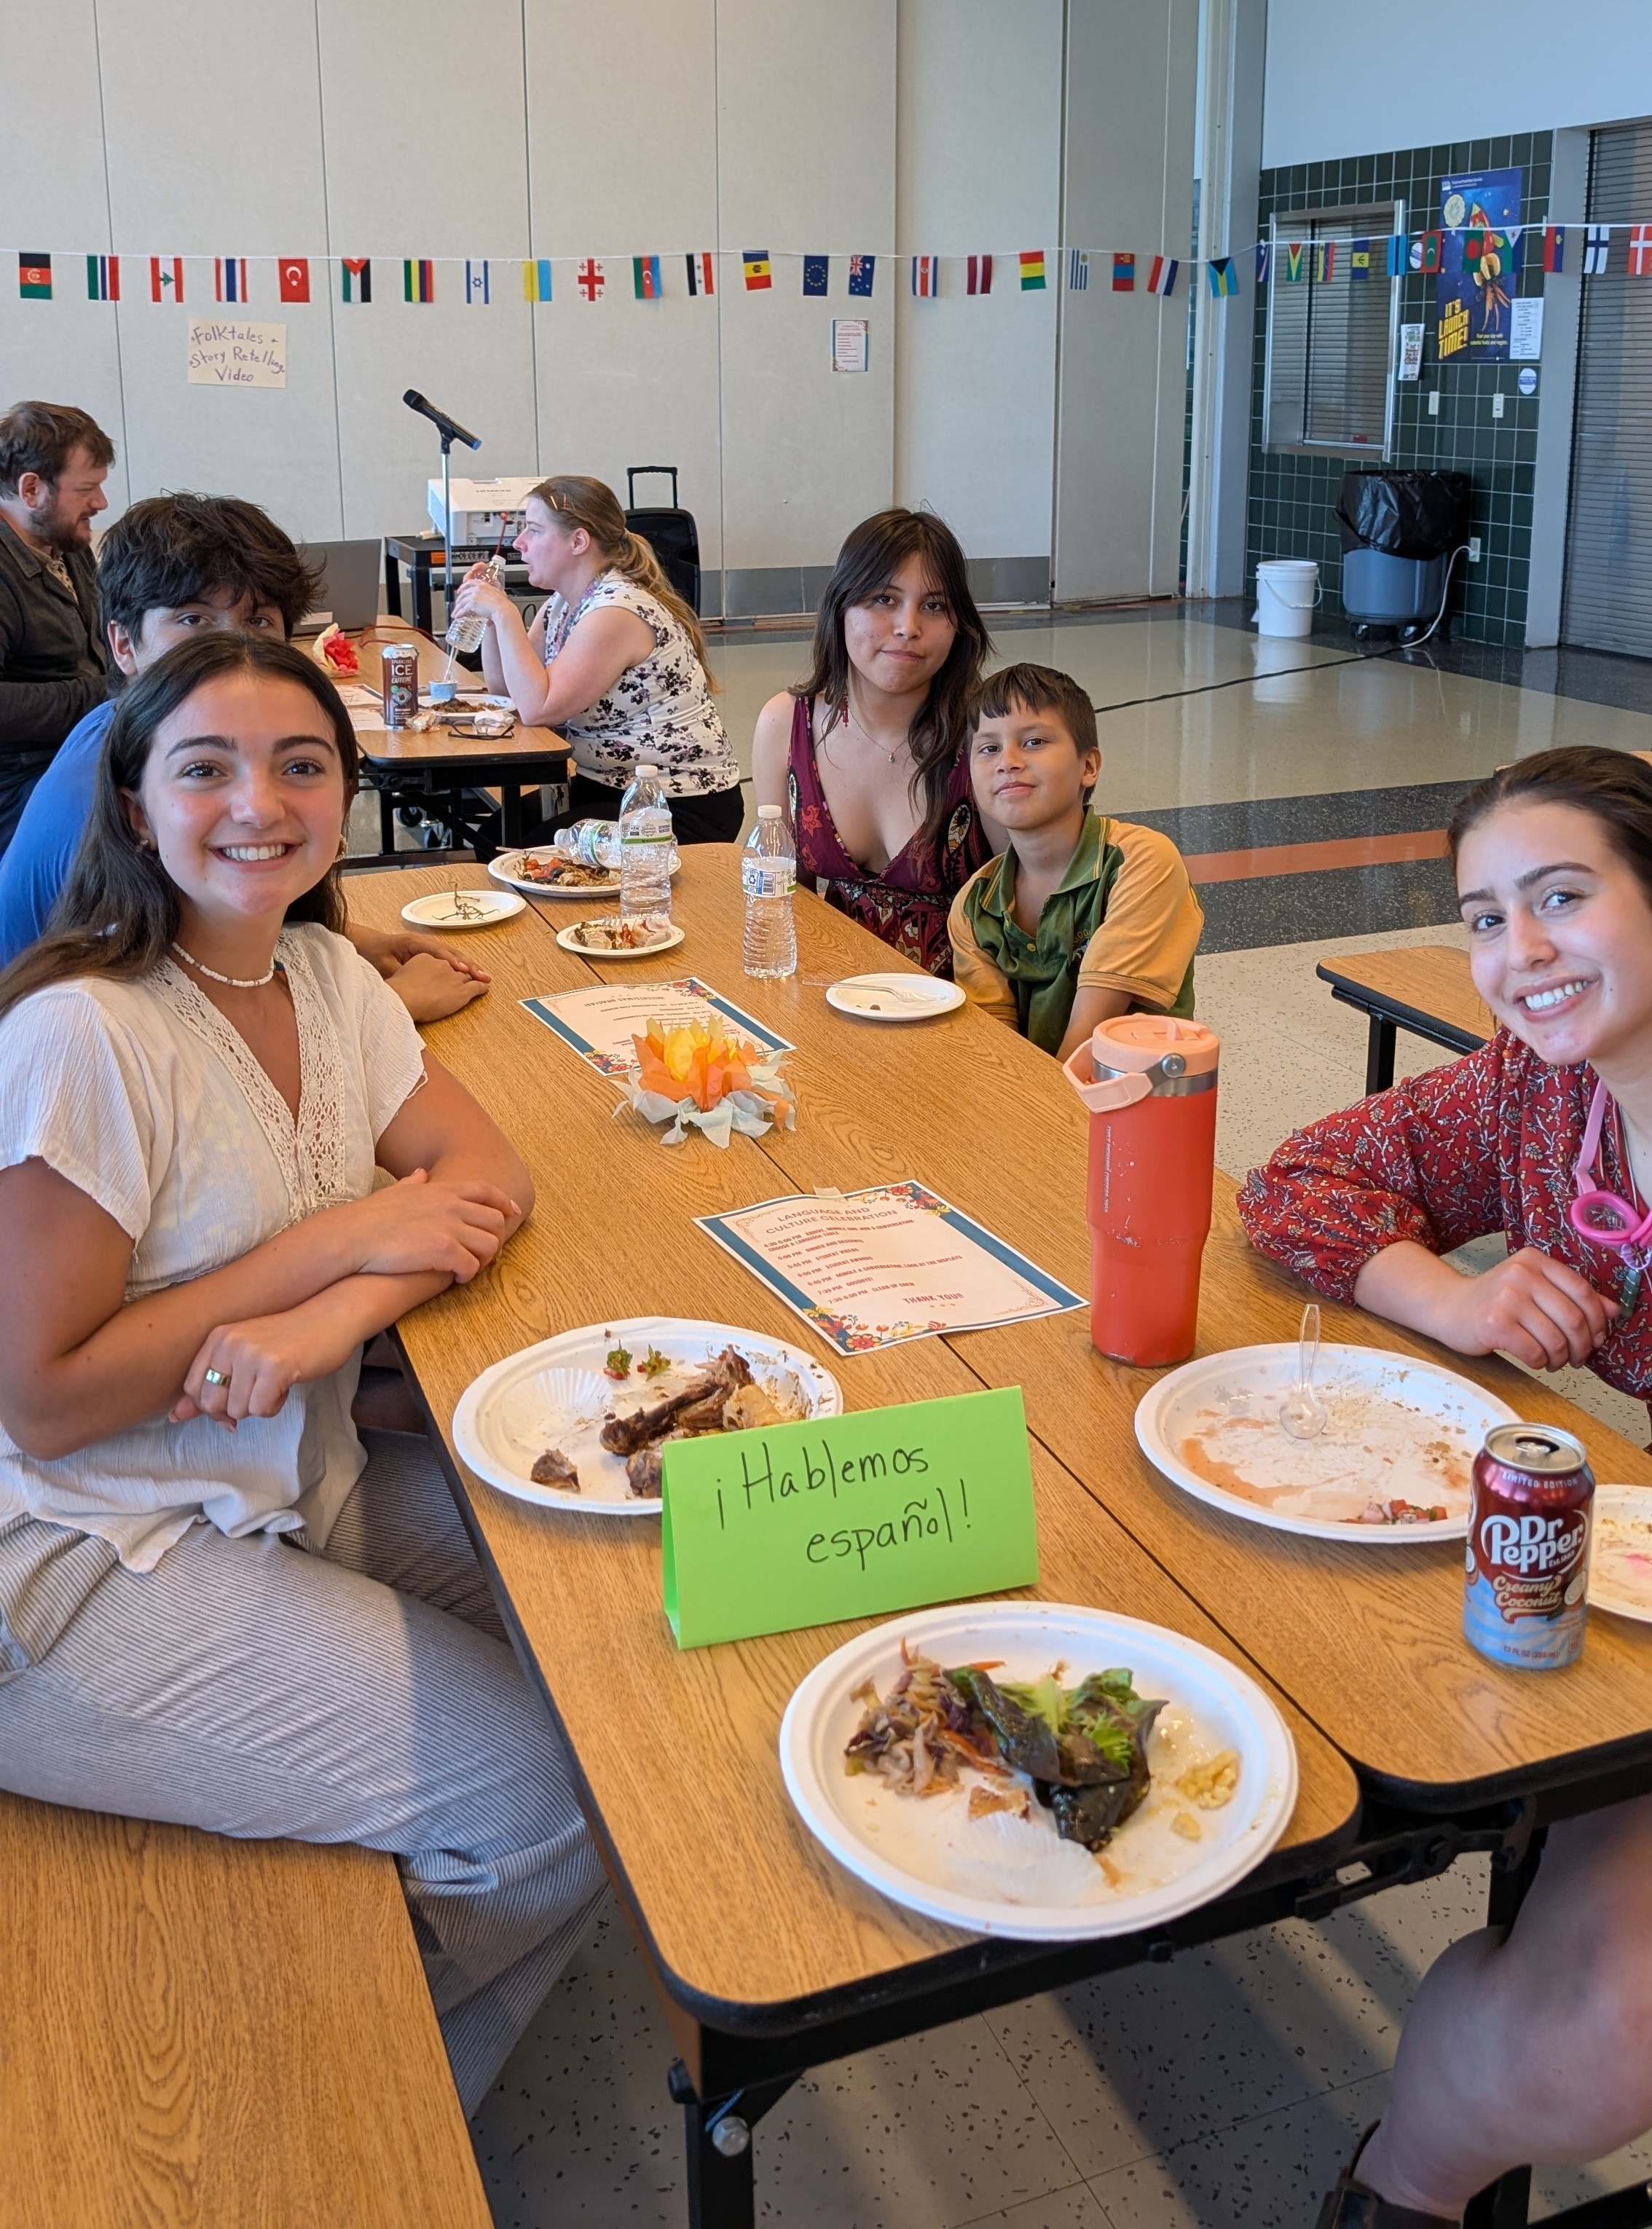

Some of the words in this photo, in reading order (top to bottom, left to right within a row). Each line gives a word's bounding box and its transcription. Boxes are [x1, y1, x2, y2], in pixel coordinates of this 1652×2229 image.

[1444, 299, 1461, 318] IT'S
[1439, 309, 1469, 340] LAUNCH
[1439, 326, 1468, 360] TIME!
[189, 350, 225, 369] Story
[215, 366, 254, 382] Video
[391, 664, 413, 676] ICE
[766, 1216, 819, 1234] CULTURE
[819, 1209, 898, 1223] CELEBRATION
[777, 1209, 843, 1222] LANGUAGE
[768, 1243, 790, 1252] CHOOSE
[795, 1234, 824, 1246] LANGUAGE
[815, 1251, 838, 1261] STUDENT
[825, 1260, 850, 1270] STUDENT
[872, 1284, 891, 1292] CLEAN
[902, 1294, 937, 1305] THANK
[1502, 1471, 1540, 1488] LIMITED
[1543, 1477, 1578, 1489] EDITION
[806, 1479, 972, 1571] español!
[1519, 1515, 1563, 1541] Dr
[1492, 1575, 1562, 1596] Creamy
[1495, 1592, 1562, 1608] Coconut
[1503, 1645, 1511, 1653] 12
[1512, 1647, 1520, 1656] FL
[1521, 1649, 1531, 1658] OZ
